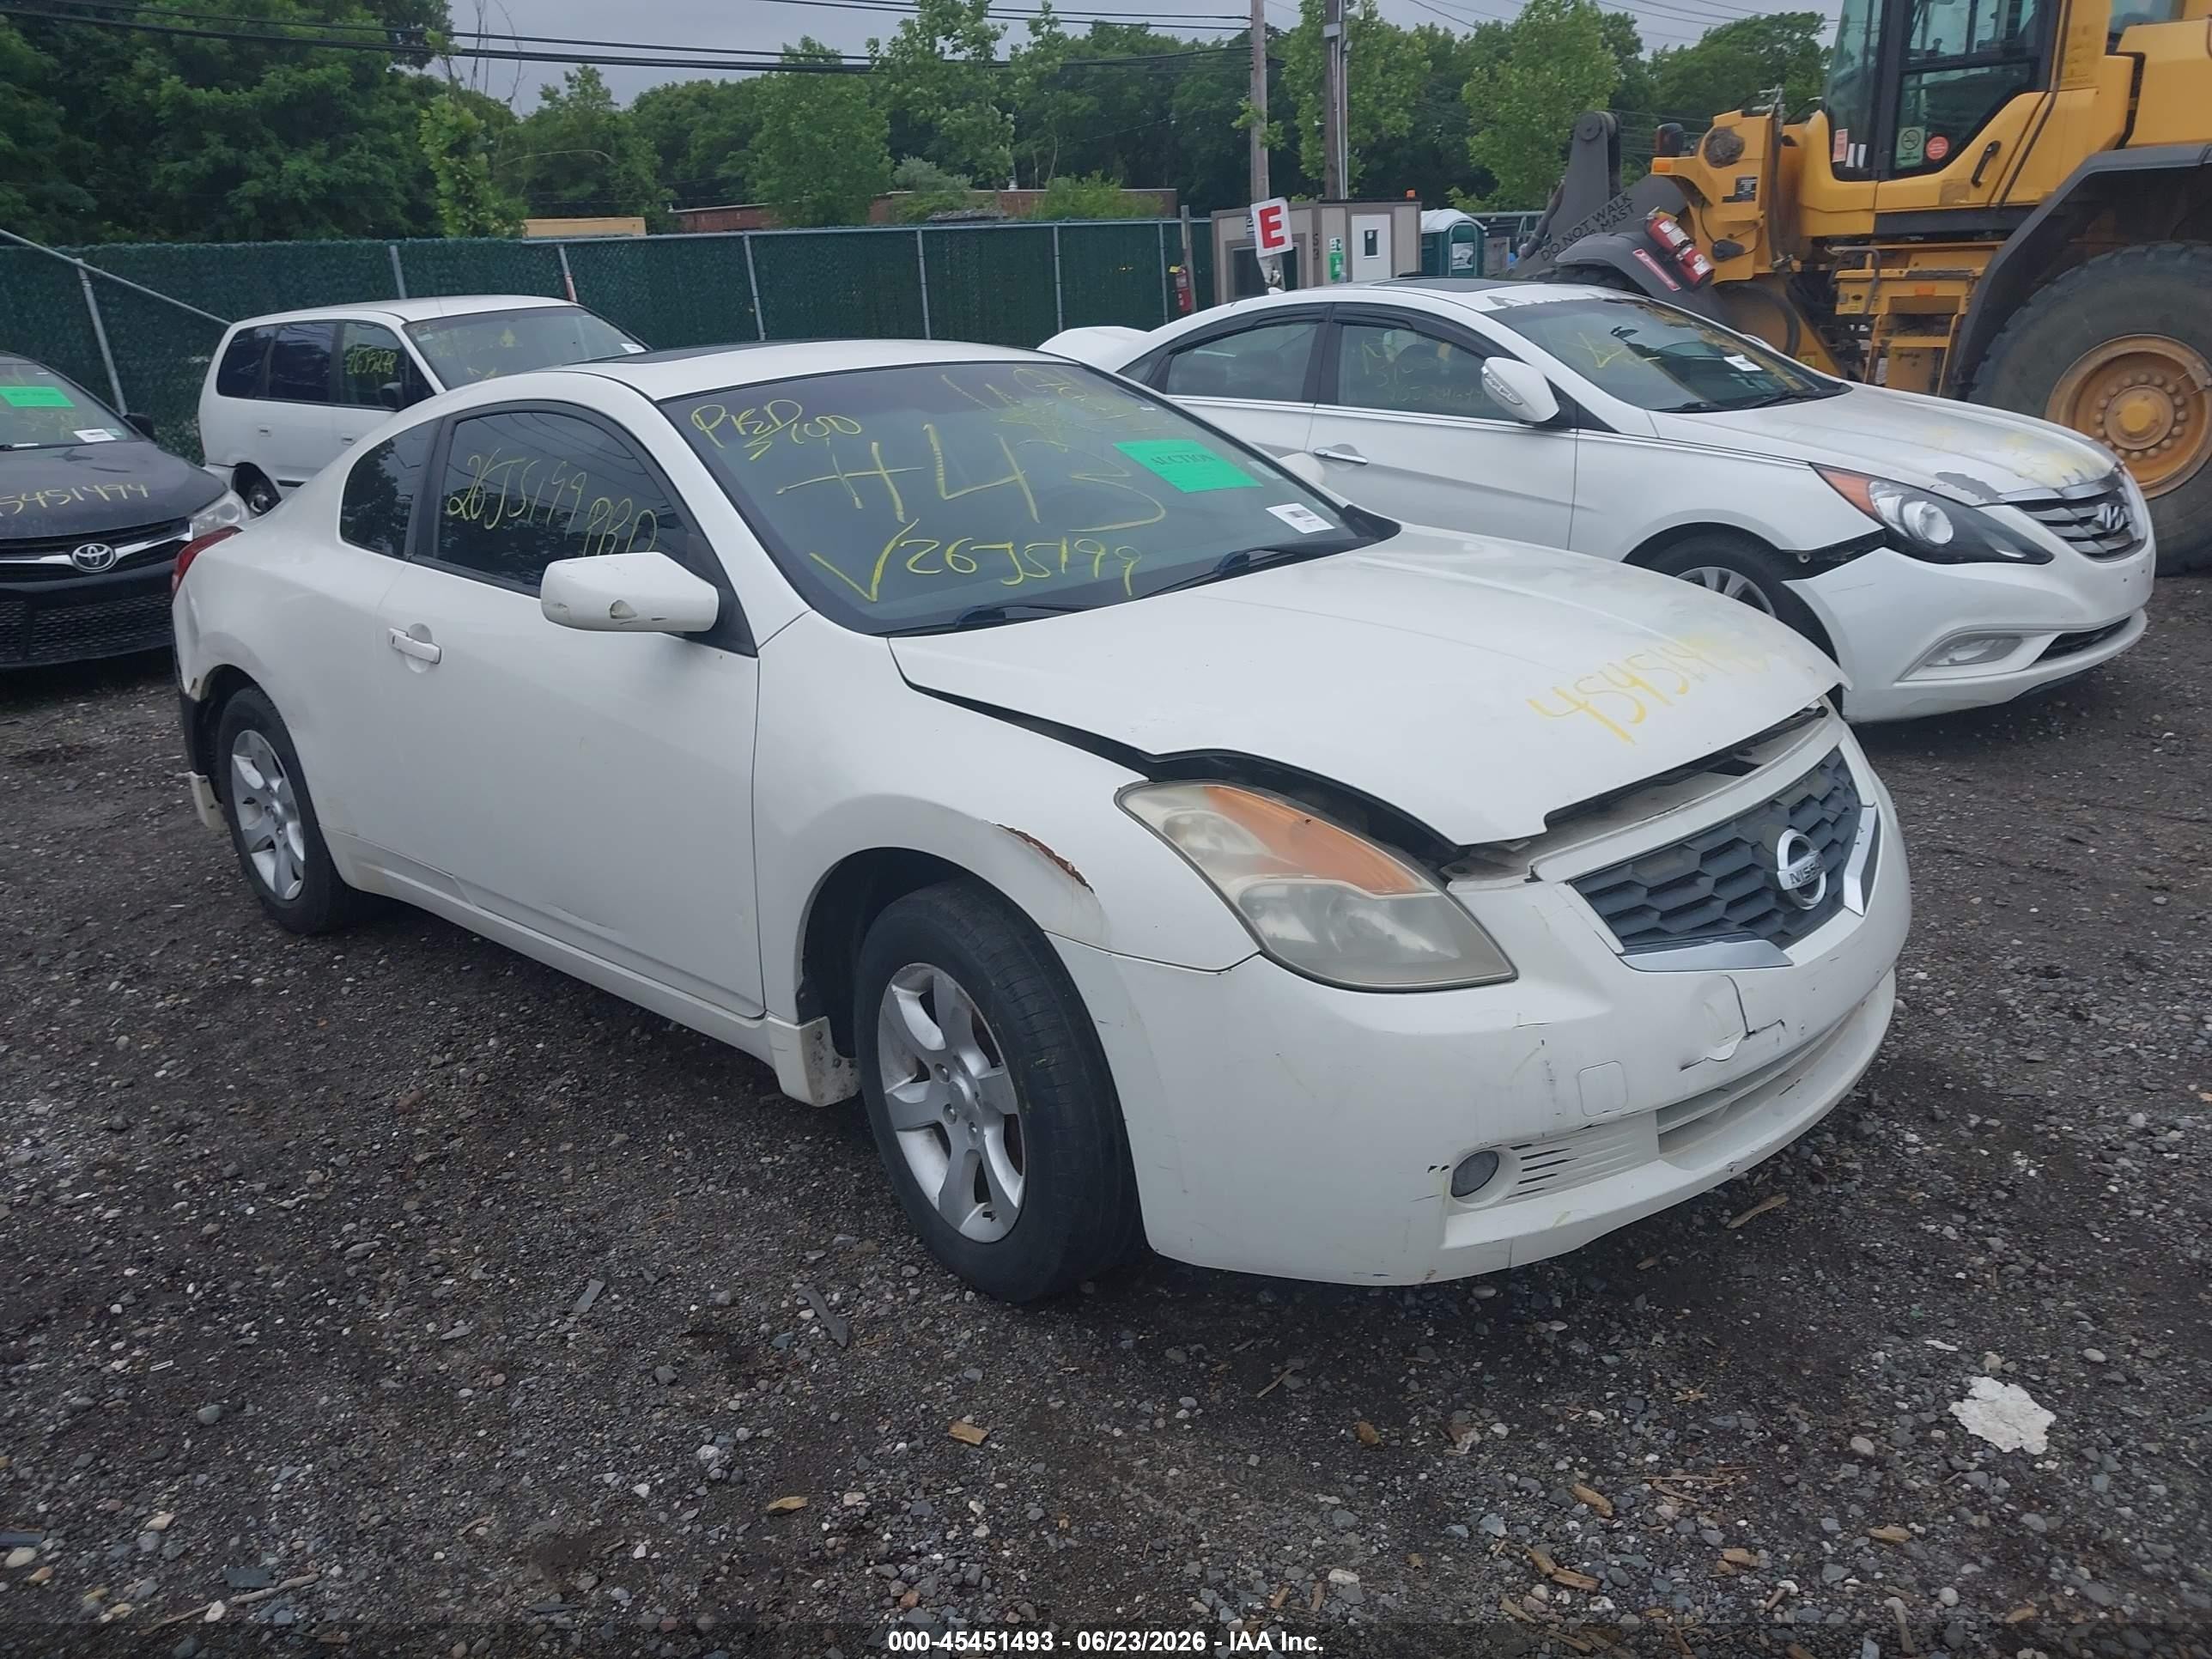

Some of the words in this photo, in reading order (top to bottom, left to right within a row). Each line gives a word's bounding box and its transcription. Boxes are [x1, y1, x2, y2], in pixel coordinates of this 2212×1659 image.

[1259, 205, 1285, 249] E
[1540, 243, 1560, 261] DO
[1562, 219, 1589, 246] NOT
[1592, 191, 1633, 222] WALK
[0, 483, 149, 515] 5451494
[776, 423, 1166, 532] #43
